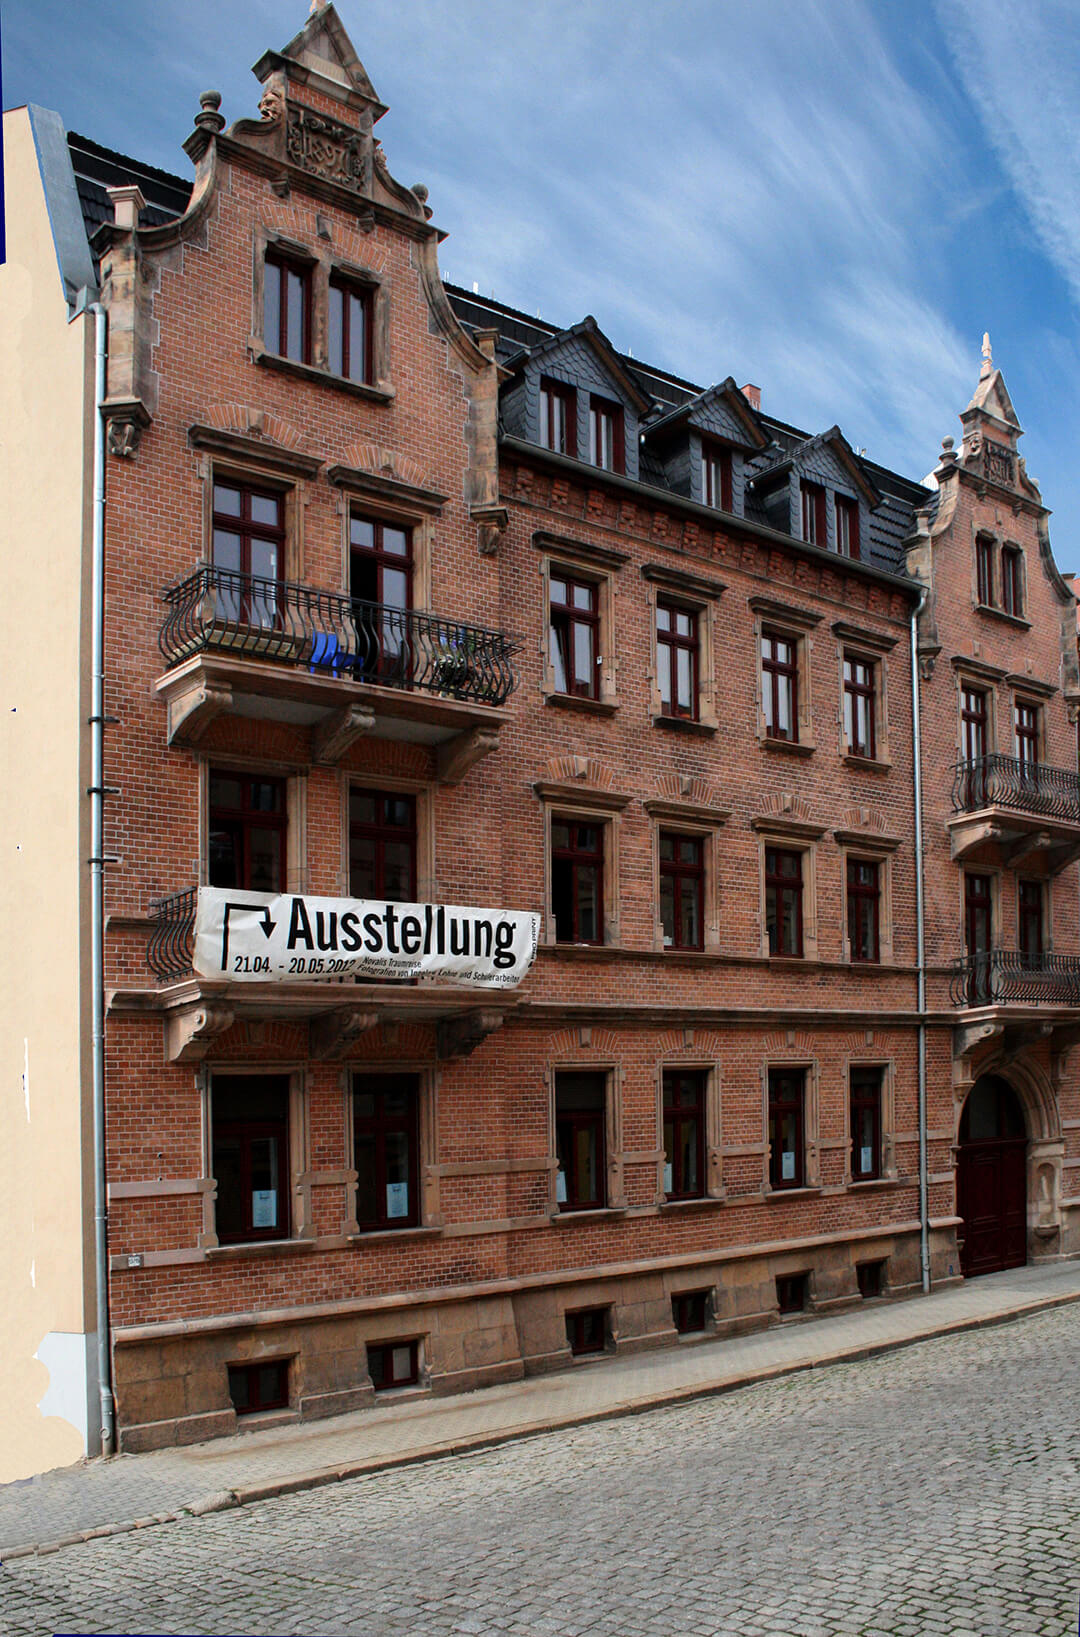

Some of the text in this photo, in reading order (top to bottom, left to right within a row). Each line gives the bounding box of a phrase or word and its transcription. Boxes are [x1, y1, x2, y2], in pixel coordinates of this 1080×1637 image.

[287, 897, 517, 968] Ausstellung
[234, 955, 273, 973] 21.04.
[288, 957, 356, 974] 20.05.2012
[362, 956, 422, 968] Novalis Traumreise
[357, 964, 397, 977] Fotografien
